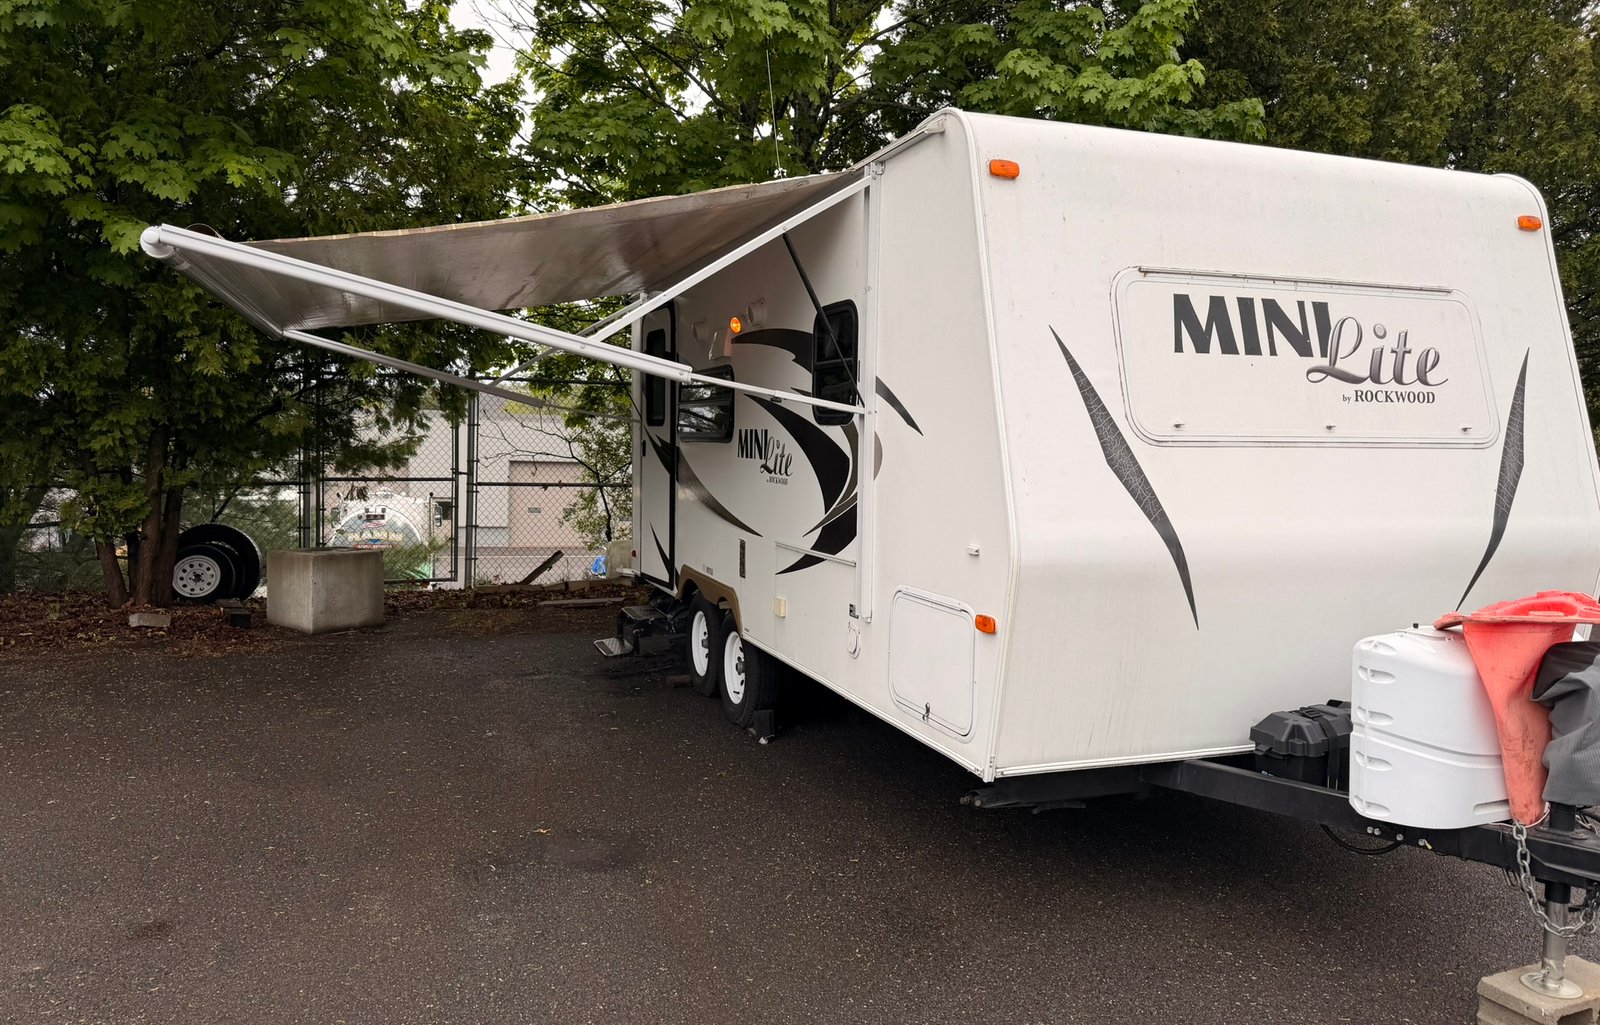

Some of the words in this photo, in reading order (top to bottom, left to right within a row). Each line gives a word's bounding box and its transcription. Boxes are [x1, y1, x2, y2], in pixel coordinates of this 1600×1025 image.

[1173, 293, 1332, 358] MINI
[1306, 316, 1448, 387] Lite
[1342, 394, 1352, 404] by
[1354, 389, 1436, 404] ROCKWOOD
[737, 429, 768, 460] MINI
[760, 436, 793, 476] Lite
